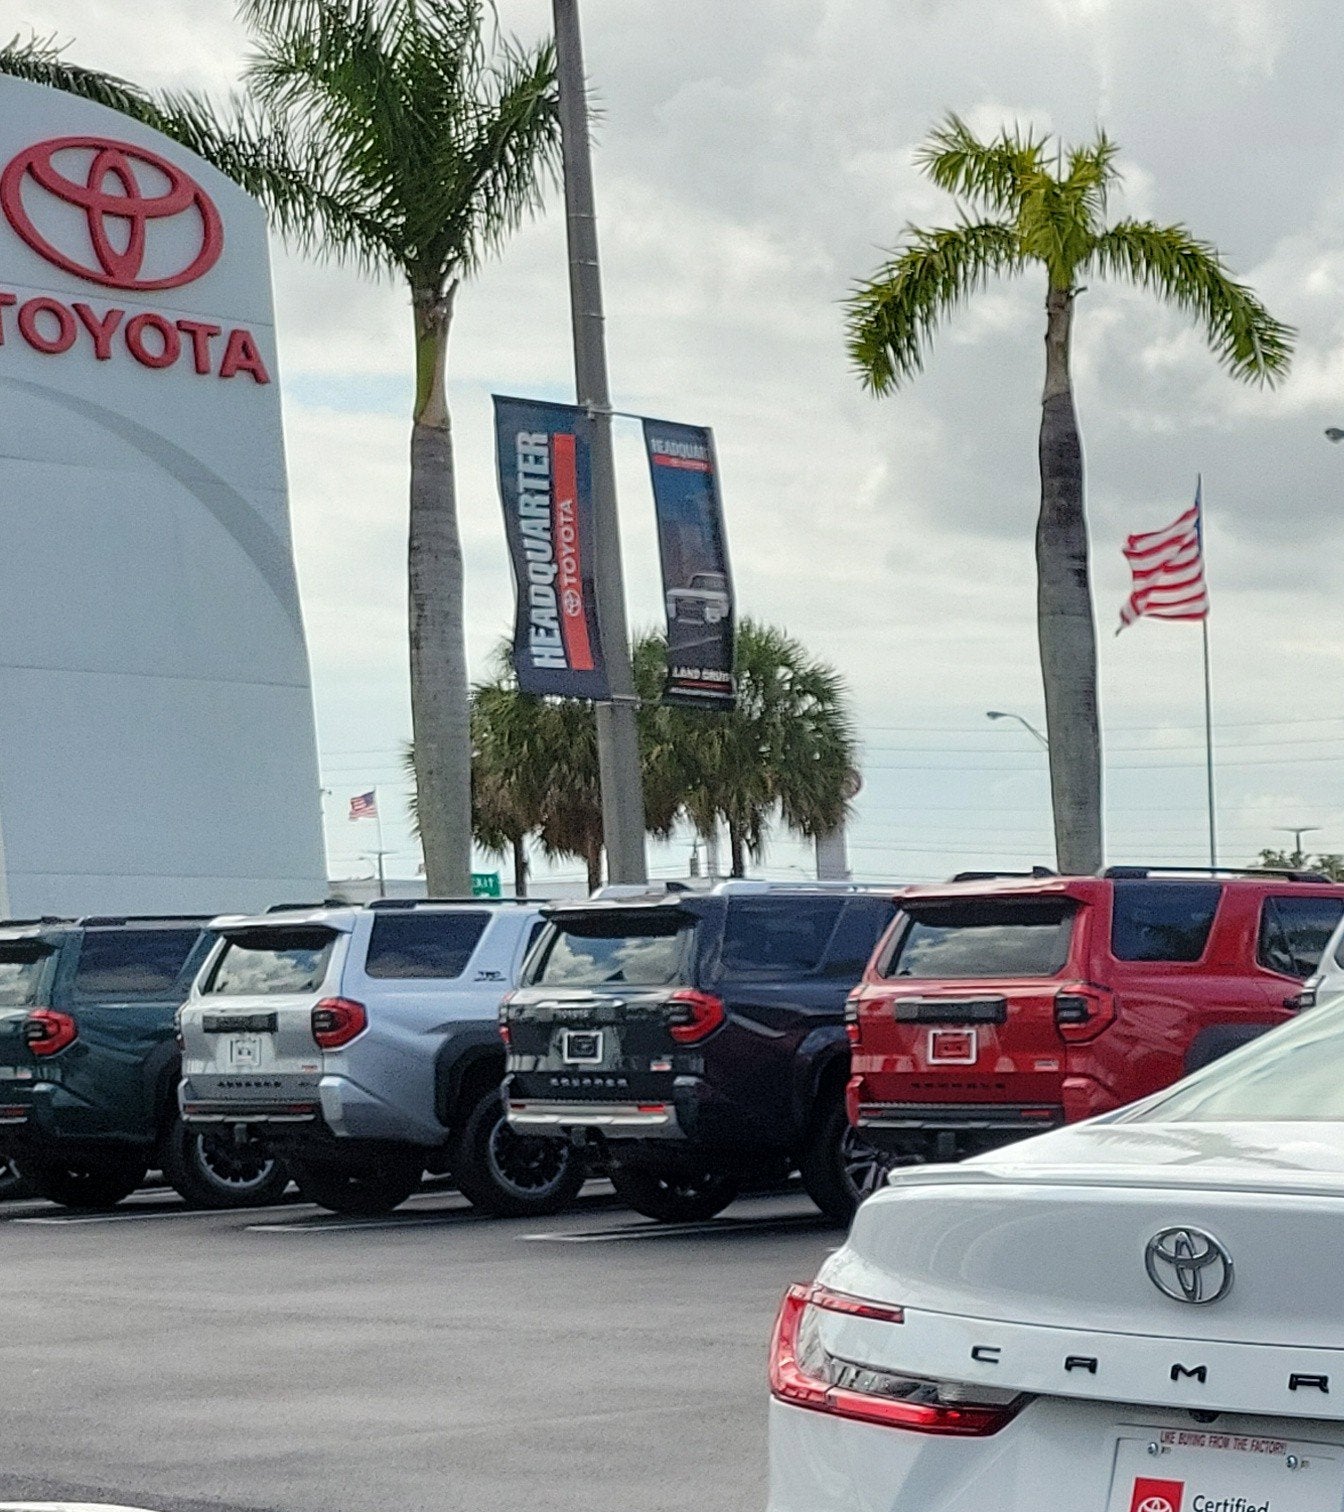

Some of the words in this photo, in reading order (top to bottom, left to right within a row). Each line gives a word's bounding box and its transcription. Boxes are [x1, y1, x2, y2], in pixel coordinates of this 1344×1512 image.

[517, 431, 568, 668] HEADQUARTER
[559, 500, 579, 585] TOYOTA
[1160, 1431, 1176, 1444] LIKE
[1178, 1432, 1207, 1447] BUYING
[1208, 1435, 1231, 1449] FROM
[1233, 1437, 1249, 1451] THE
